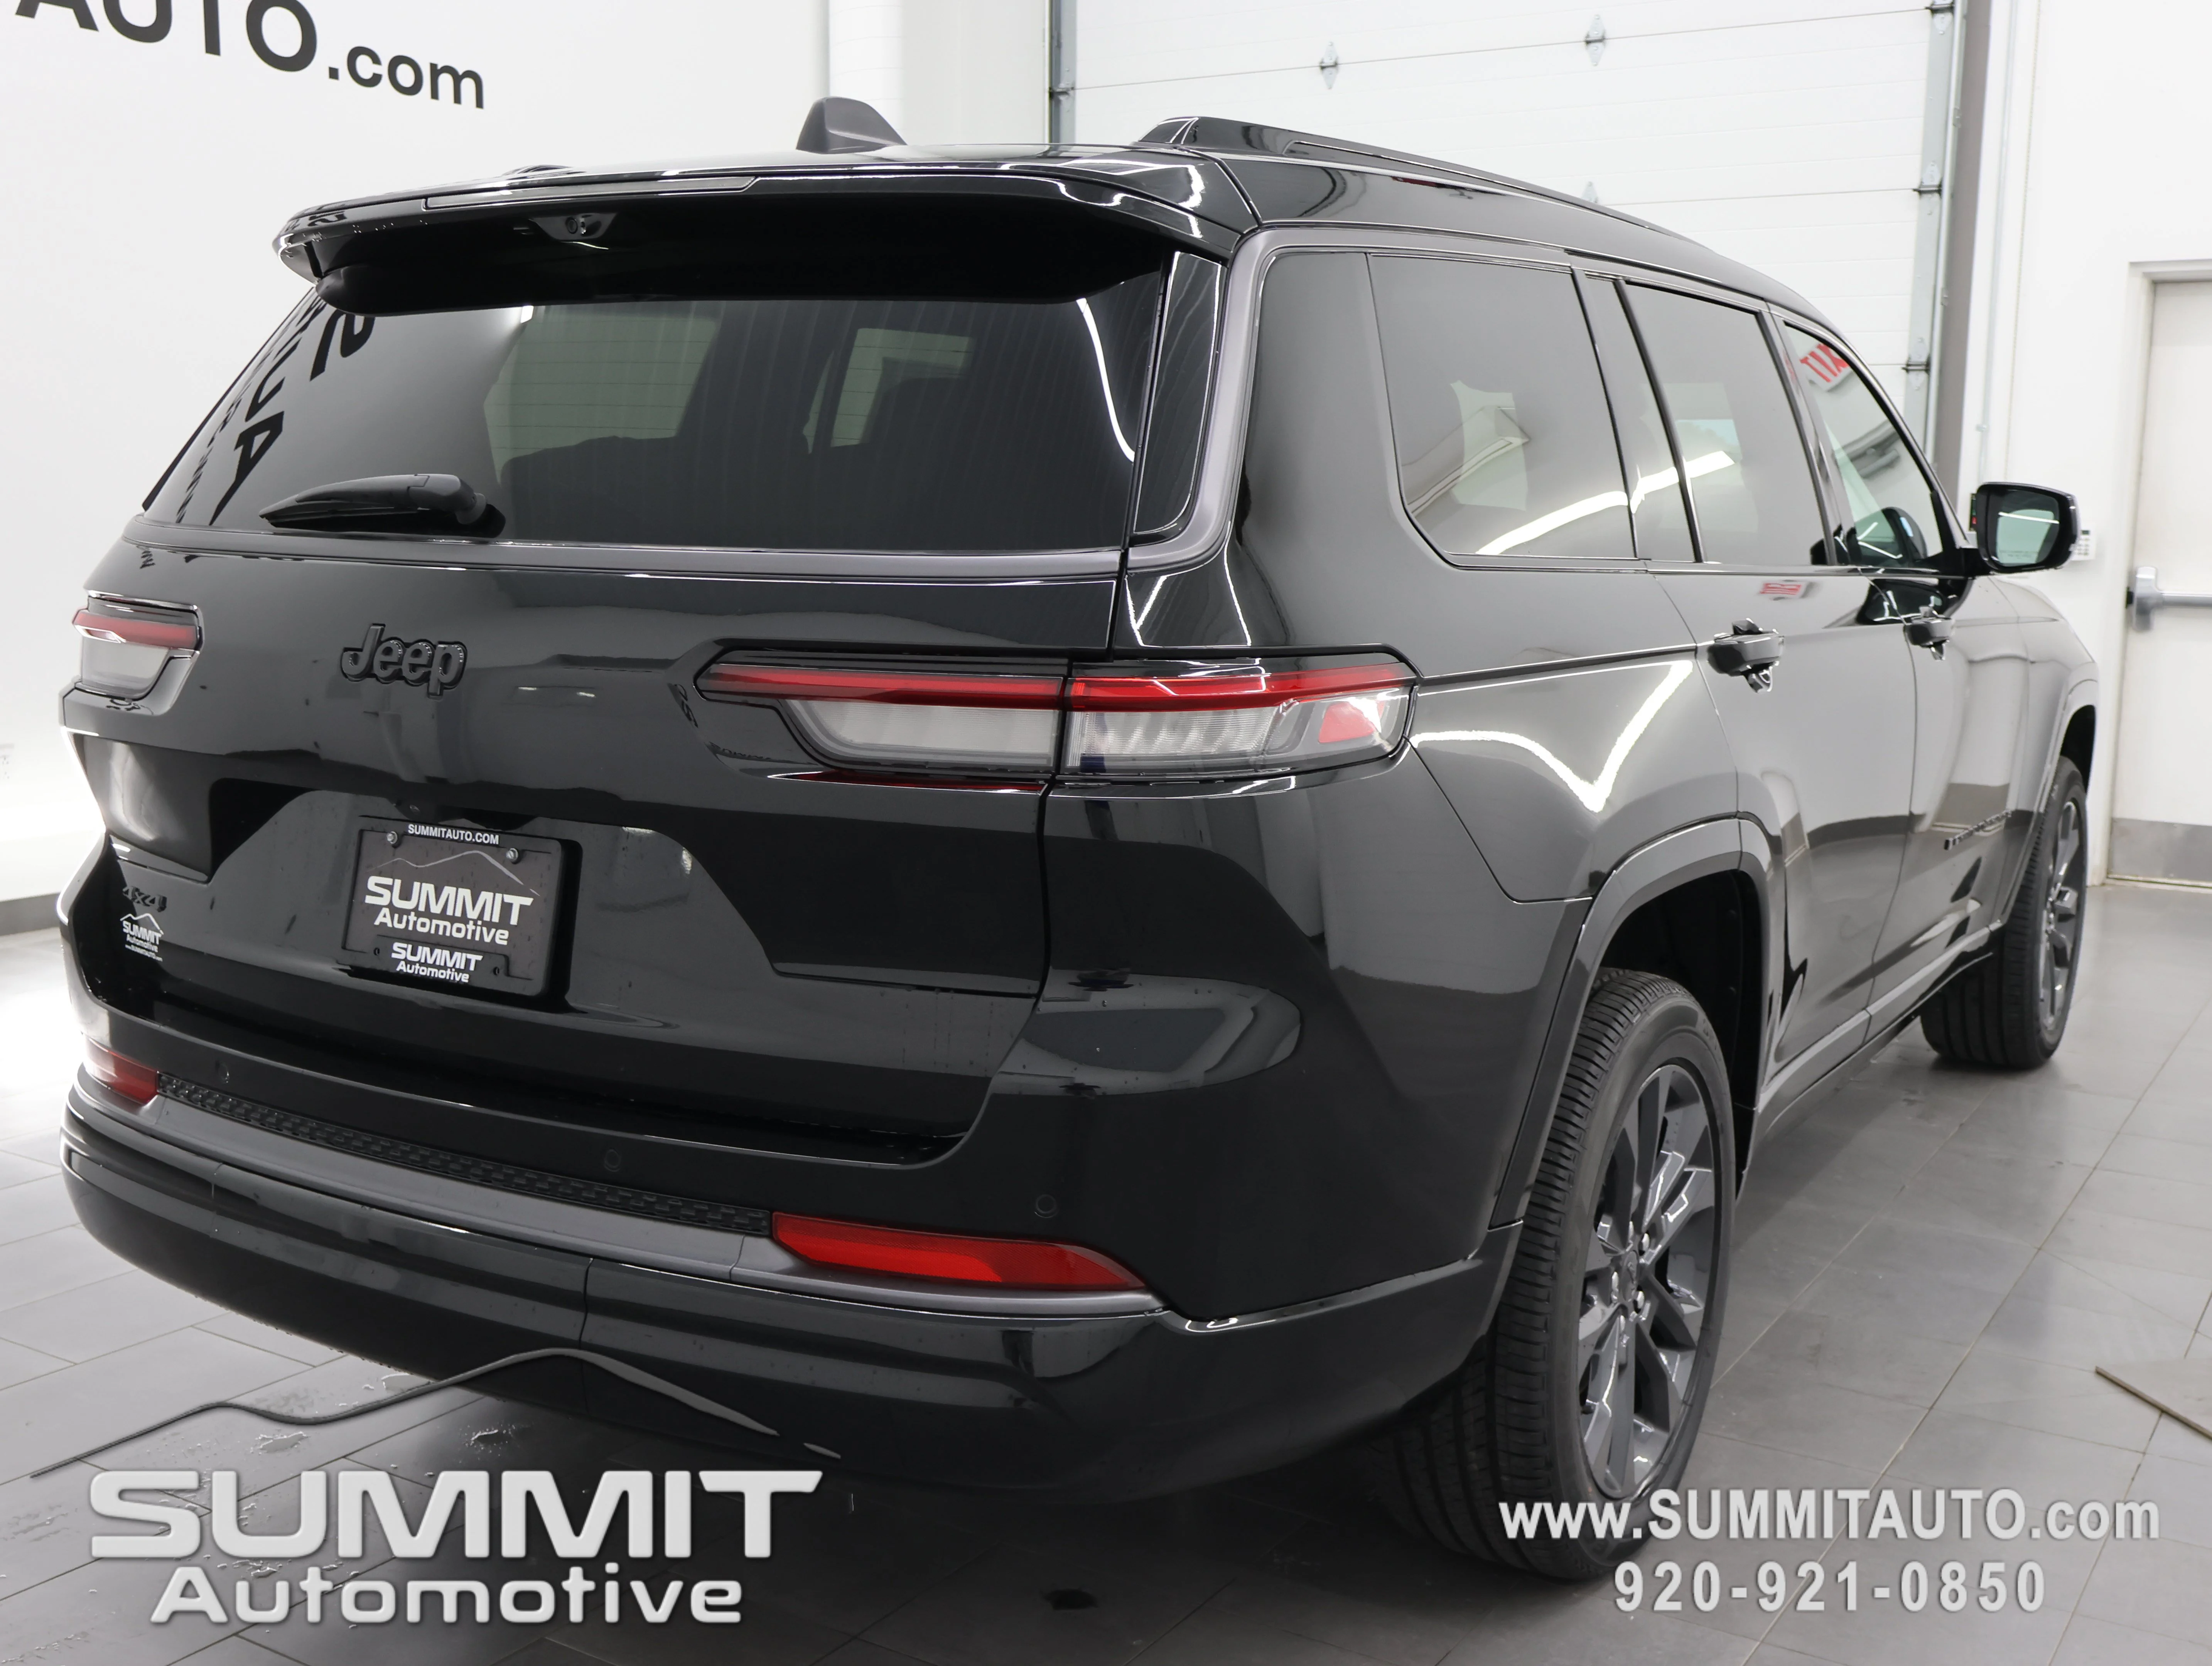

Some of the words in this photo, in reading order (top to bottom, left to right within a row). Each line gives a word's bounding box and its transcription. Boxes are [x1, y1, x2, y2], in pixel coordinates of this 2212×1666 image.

[341, 623, 467, 700] Jeep
[408, 824, 499, 845] SUMMITAUTO.COM
[364, 875, 534, 926] SUMMIT
[122, 920, 162, 945] SUMMIT
[374, 907, 509, 945] Automotive
[391, 942, 483, 971] SUMMIT
[396, 961, 470, 983] Automotive
